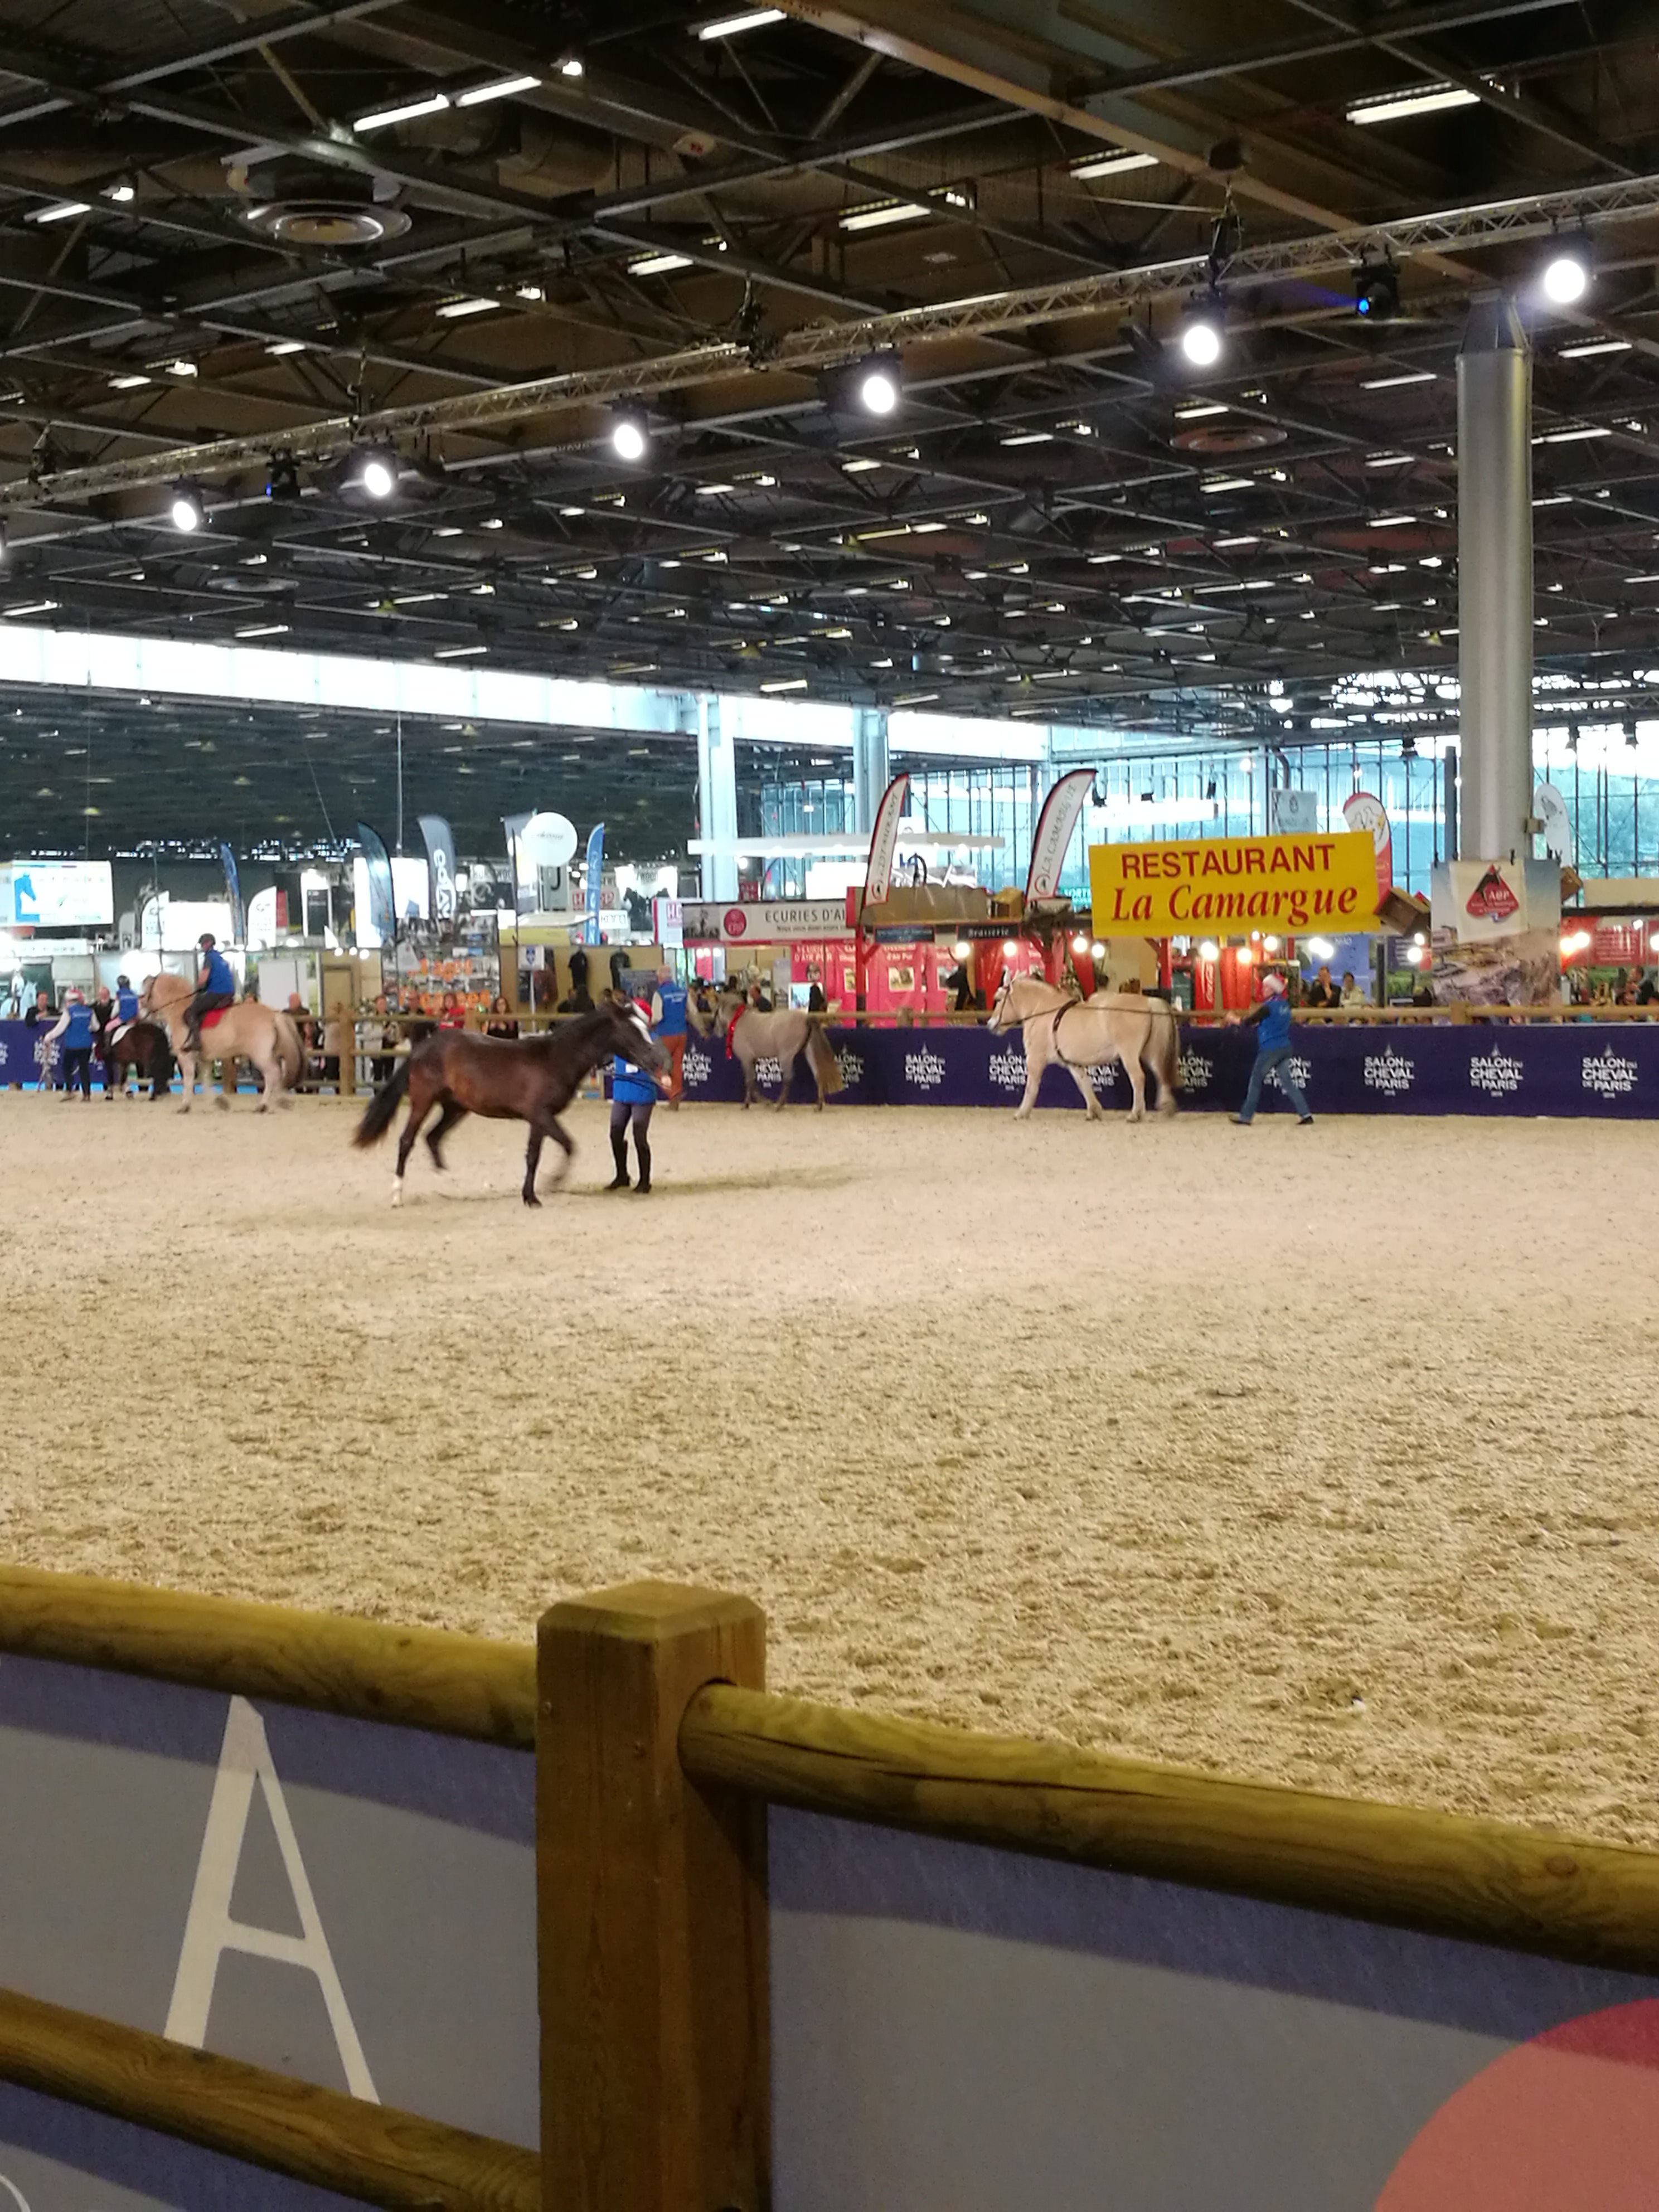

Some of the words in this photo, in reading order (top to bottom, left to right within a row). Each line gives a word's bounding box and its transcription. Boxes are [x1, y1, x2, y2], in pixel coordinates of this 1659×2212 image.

[1121, 843, 1335, 879] RESTAURANT
[1112, 887, 1153, 921] La
[1168, 884, 1358, 927] Camargue
[765, 909, 818, 923] ECURIES
[822, 909, 845, 921] D'AI
[905, 1054, 937, 1064] SALON
[989, 1054, 1022, 1065] SALON
[1364, 1056, 1404, 1068] SALON
[1471, 1056, 1512, 1068] SALON
[1582, 1056, 1626, 1069] SALON
[905, 1064, 945, 1075] CHEVAL
[1364, 1067, 1415, 1079] CHEVAL
[1470, 1068, 1524, 1080] CHEVAL
[1582, 1069, 1638, 1081] CHEVAL
[914, 1074, 942, 1084] PARIS
[1375, 1079, 1410, 1090] PARIS
[1481, 1079, 1518, 1090] PARIS
[1594, 1080, 1632, 1092] PARIS
[163, 1694, 381, 2106] A
